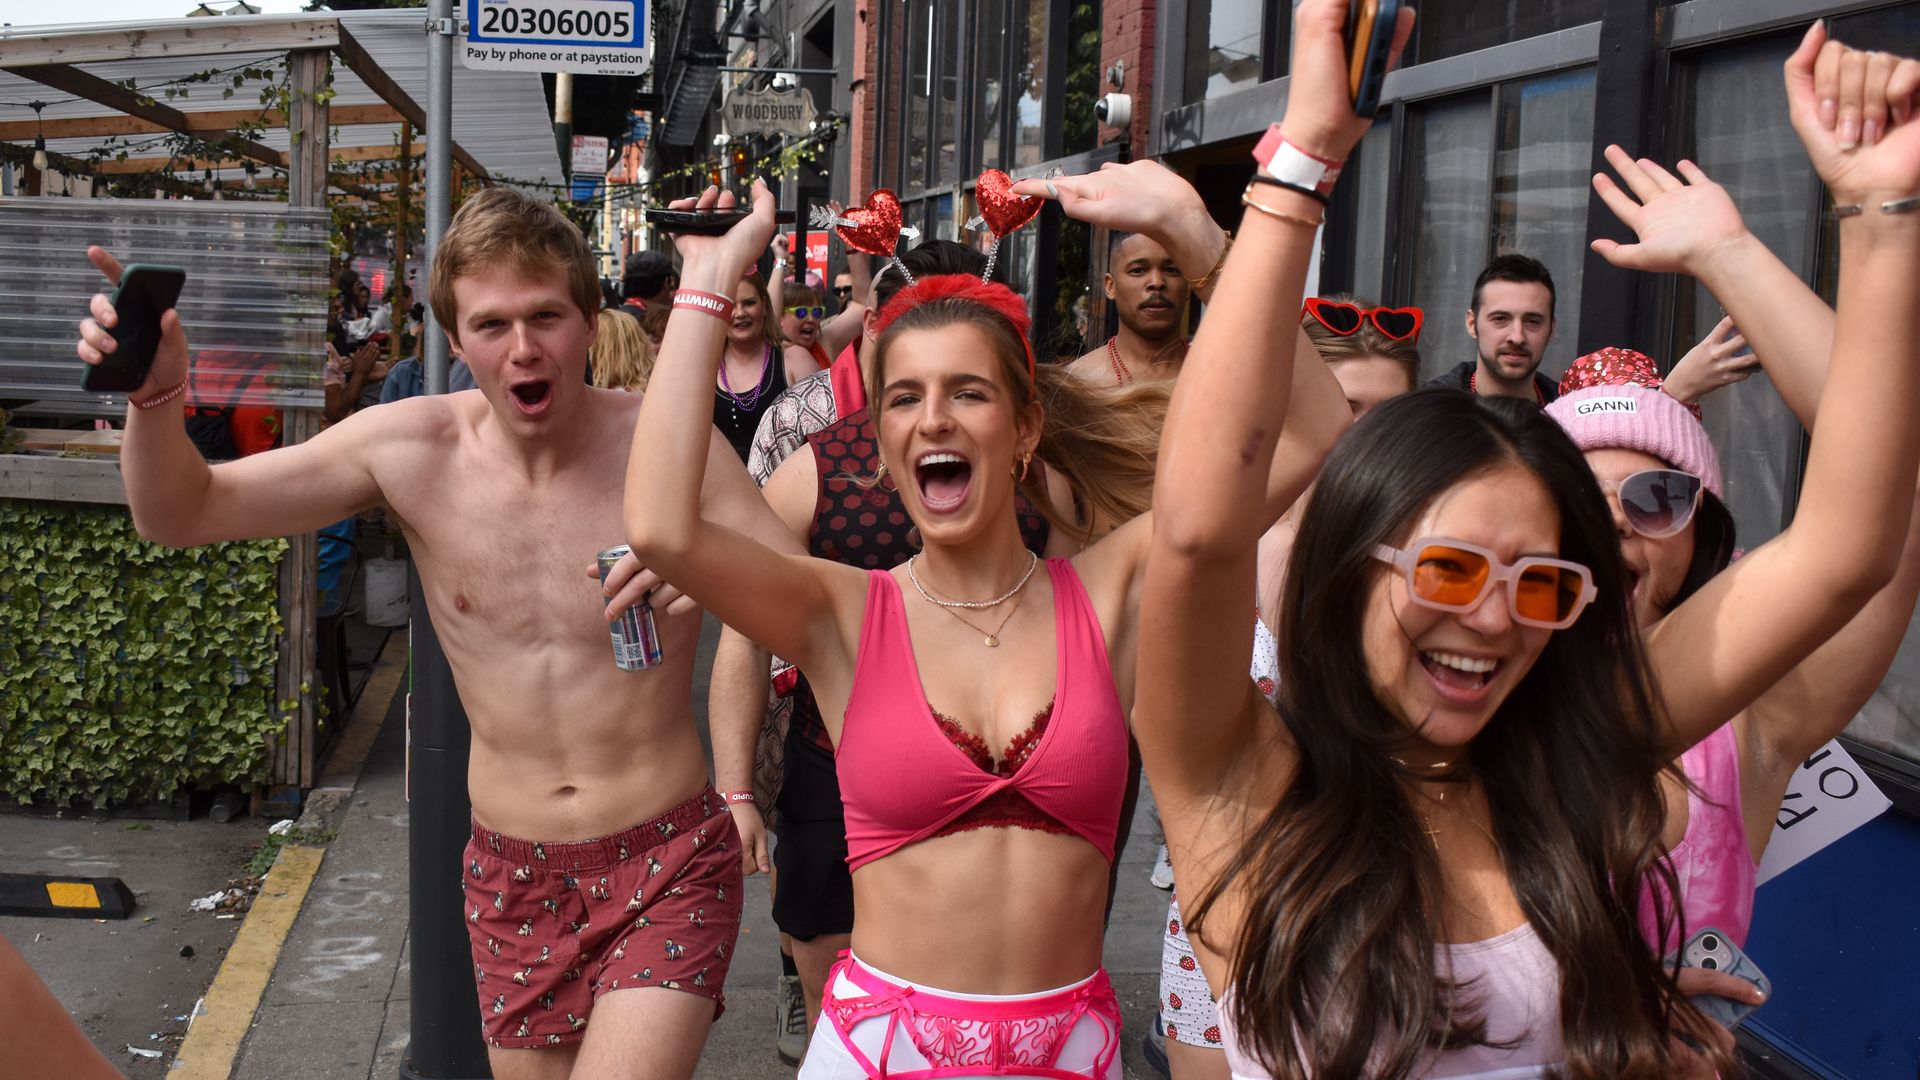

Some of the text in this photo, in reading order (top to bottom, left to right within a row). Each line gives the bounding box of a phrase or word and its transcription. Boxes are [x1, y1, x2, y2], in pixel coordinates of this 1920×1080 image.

[483, 7, 630, 37] 20306005
[467, 48, 643, 65] Pay by phone or at paystation
[732, 104, 803, 120] WOODBURY
[1577, 400, 1635, 415] GANNI
[732, 793, 754, 801] CUPID
